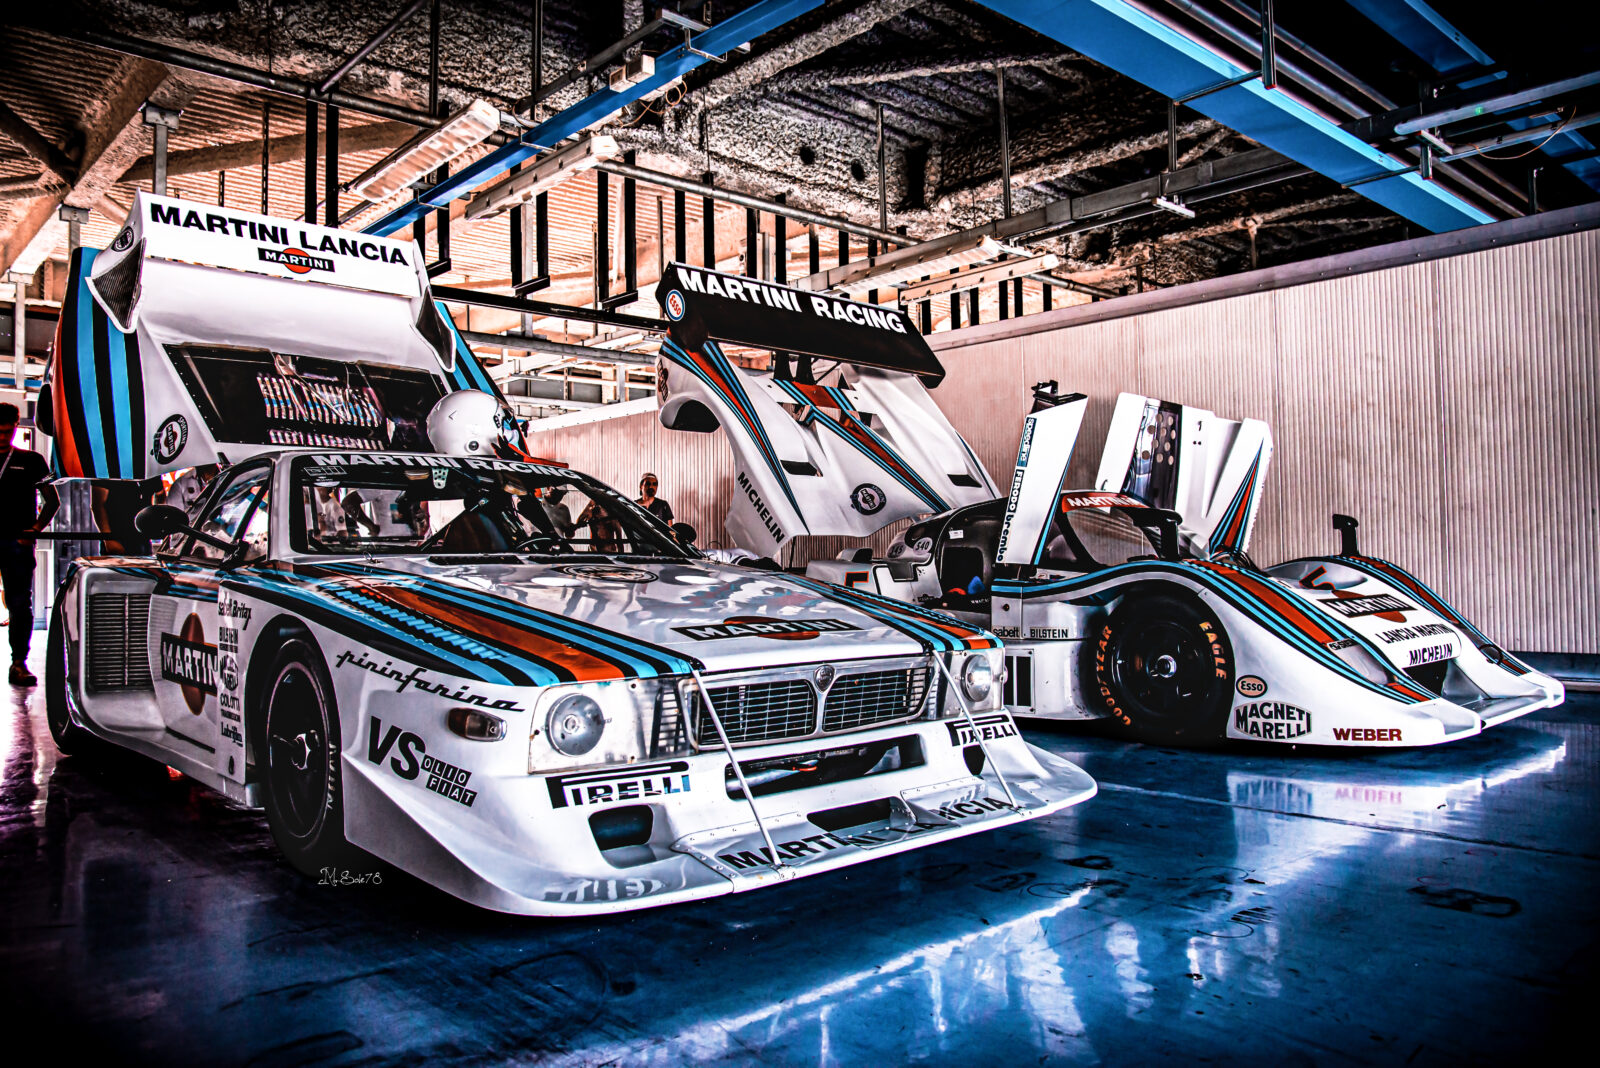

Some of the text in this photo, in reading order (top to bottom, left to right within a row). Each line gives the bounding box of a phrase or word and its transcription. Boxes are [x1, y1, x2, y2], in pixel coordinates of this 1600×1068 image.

[150, 203, 409, 266] MARTINI LANCIA
[265, 250, 332, 271] MARTINI
[676, 268, 907, 335] MARTINI RACING
[167, 425, 175, 454] MARTINI
[311, 455, 582, 480] MARTINI RACING
[1009, 471, 1023, 511] FERODO
[738, 471, 785, 544] MICHELIN
[997, 513, 1014, 562] brembo
[1300, 565, 1336, 590] 5
[1328, 594, 1411, 614] MARTINI
[695, 619, 851, 639] MARTINI
[1030, 628, 1068, 638] BILSTEIN
[1376, 623, 1454, 644] LANCIA MARTINI
[163, 642, 218, 686] MARTIN
[1199, 621, 1227, 680] EAGLE
[1409, 643, 1453, 665] MICHELIN
[337, 649, 525, 712] pininfarina
[1236, 702, 1312, 726] MAGNETI
[1236, 714, 1312, 739] MARELLI
[944, 714, 1017, 747] PIRELLI
[1333, 728, 1403, 742] WEBER
[367, 716, 426, 782] VS
[423, 757, 468, 784] OLIO
[429, 778, 475, 806] FIAT
[546, 761, 691, 809] PIRELLI
[719, 796, 1012, 870] MARTINI LANCIA
